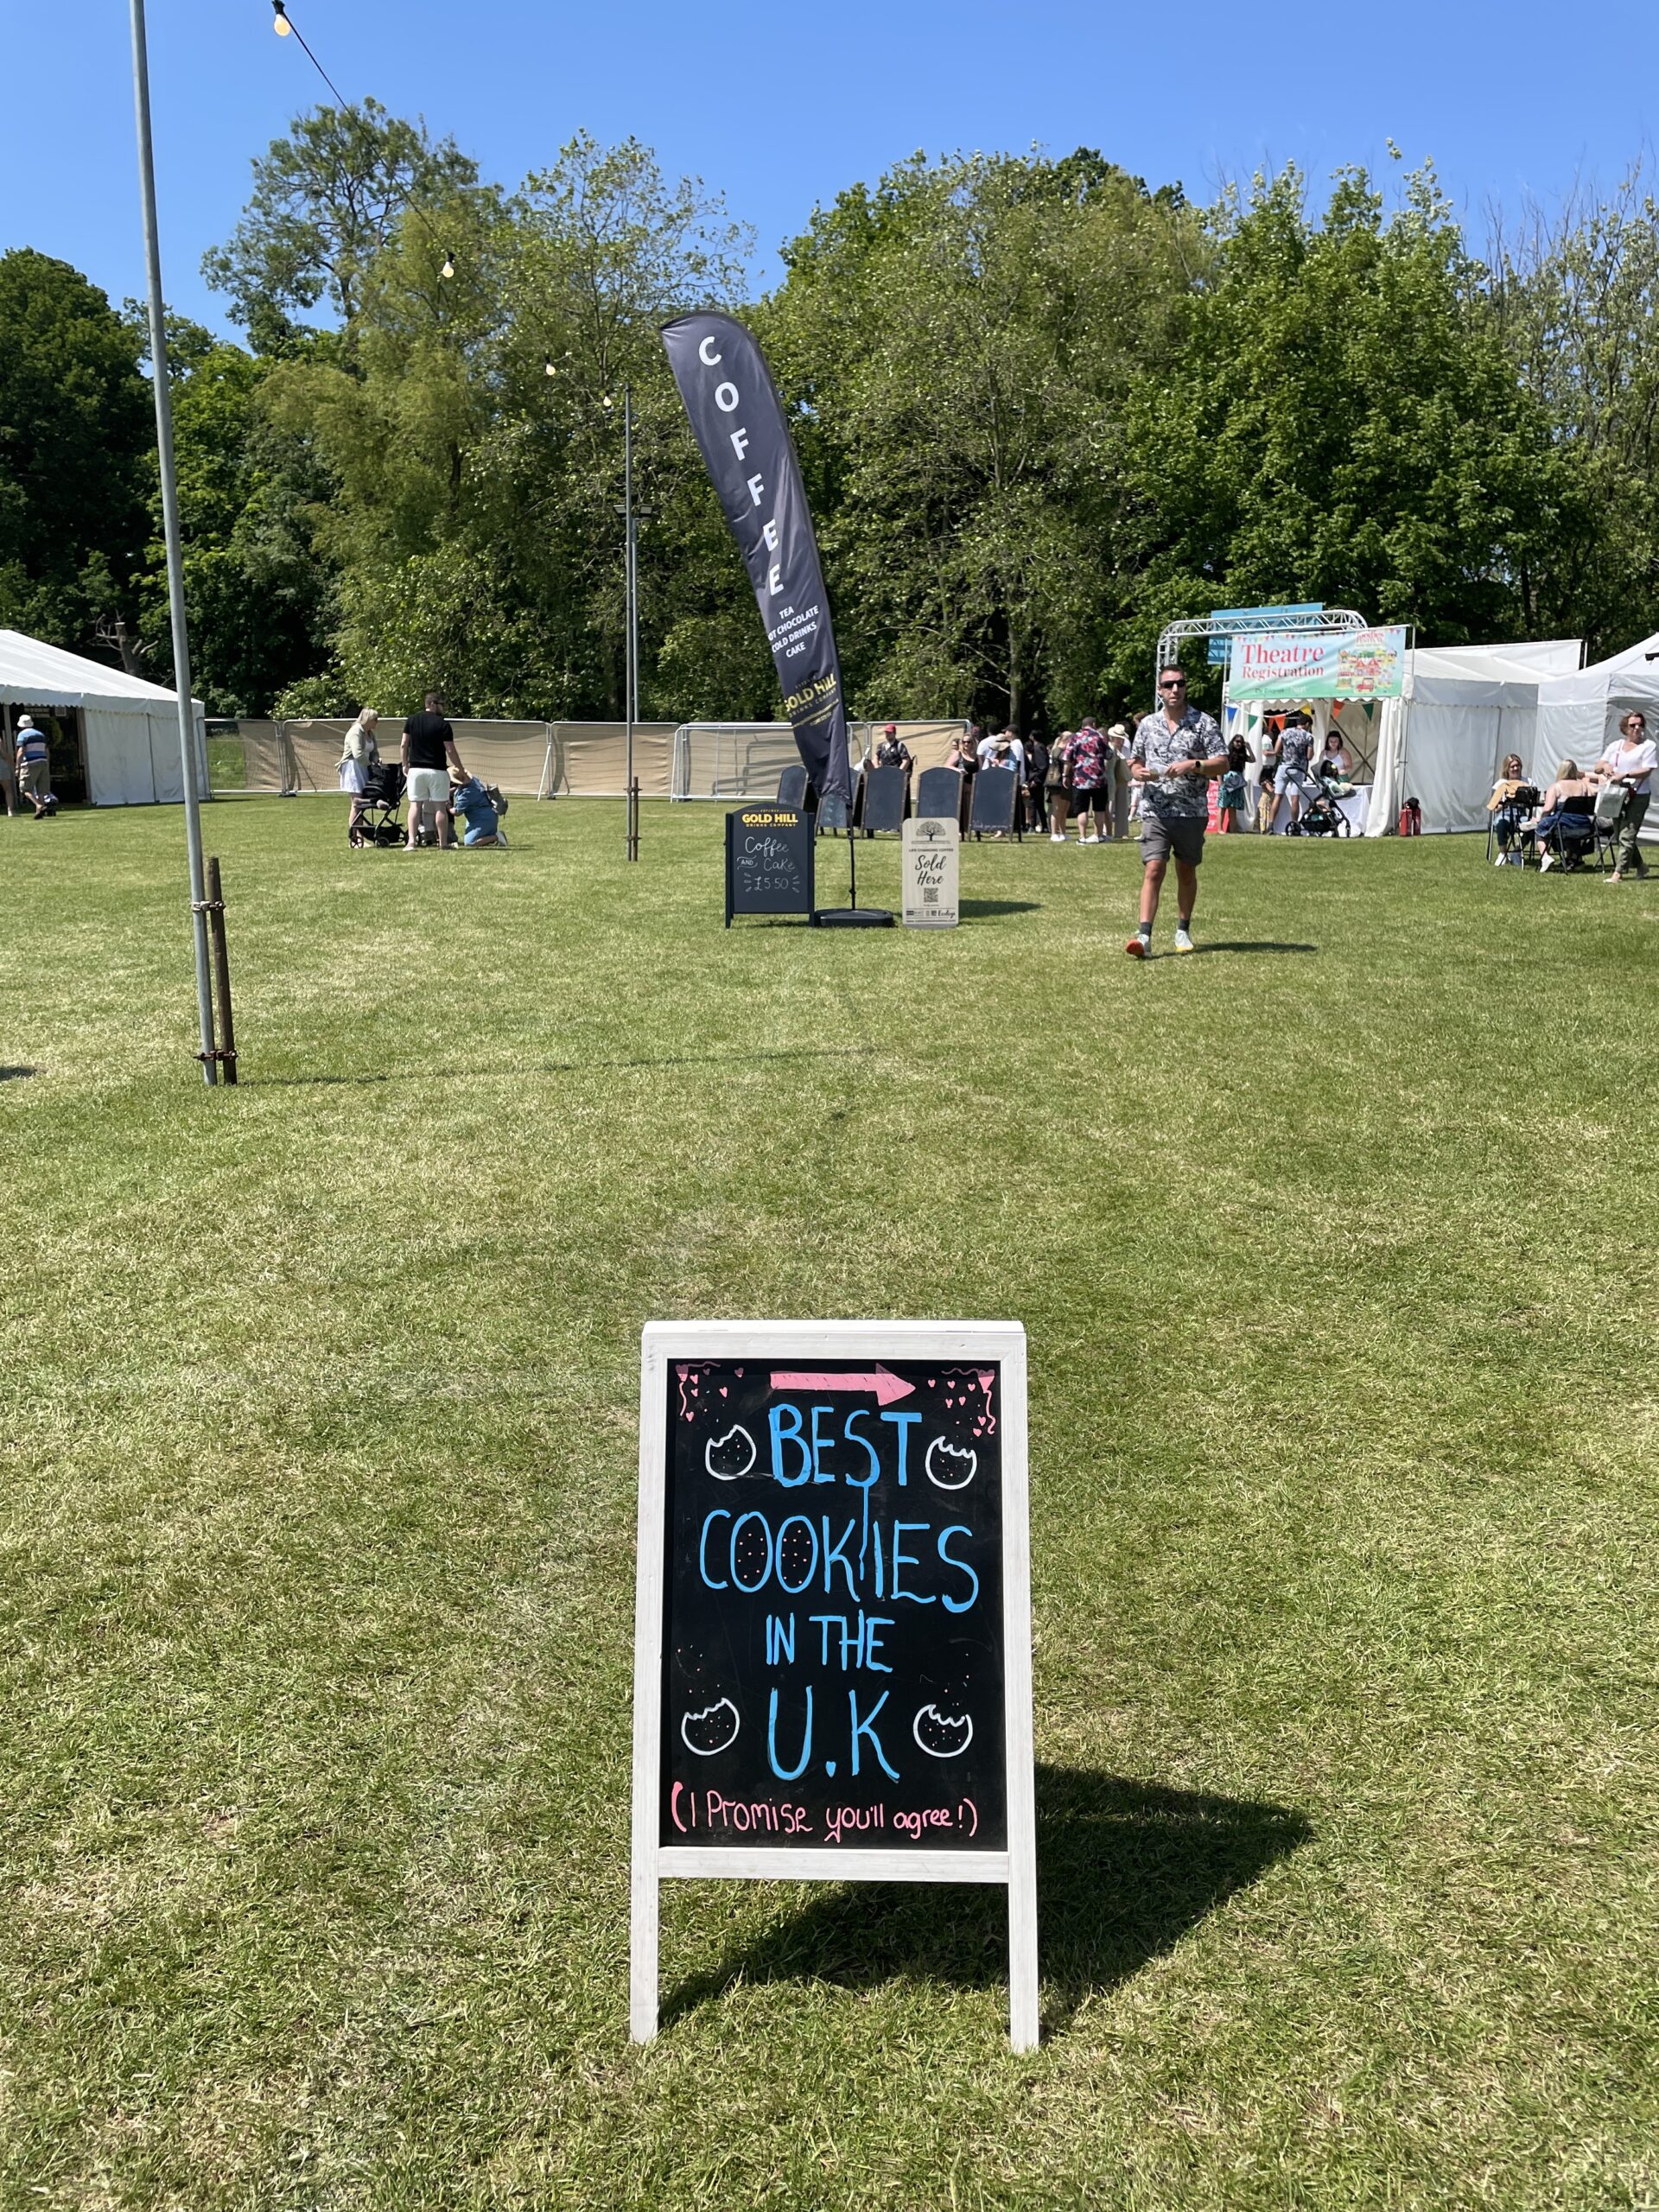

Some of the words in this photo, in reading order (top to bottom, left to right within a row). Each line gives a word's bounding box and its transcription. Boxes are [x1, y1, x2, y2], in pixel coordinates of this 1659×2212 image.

[698, 335, 785, 596] COFFEE
[767, 629, 777, 641] OT
[777, 605, 819, 635] CHOCOLATE
[779, 606, 794, 619] TEA
[772, 637, 789, 653] COLD
[788, 621, 817, 643] DRINKS
[785, 641, 806, 658] CAKE
[1241, 644, 1324, 664] Theatre
[1243, 664, 1324, 681] Registration
[813, 673, 837, 695] HILL
[741, 813, 772, 823] GOLD
[774, 813, 799, 823] HILL
[745, 836, 790, 858] Coffee
[915, 854, 947, 872] Sold
[917, 870, 944, 887] Here
[768, 1403, 922, 1488] BEST
[700, 1509, 979, 1613] COOKIES
[766, 1613, 795, 1665] IN
[809, 1610, 895, 1673] THE
[767, 1686, 900, 1782] U.K
[708, 1789, 813, 1833] Promise
[824, 1802, 884, 1843] you'll
[895, 1797, 979, 1840] agree!)
